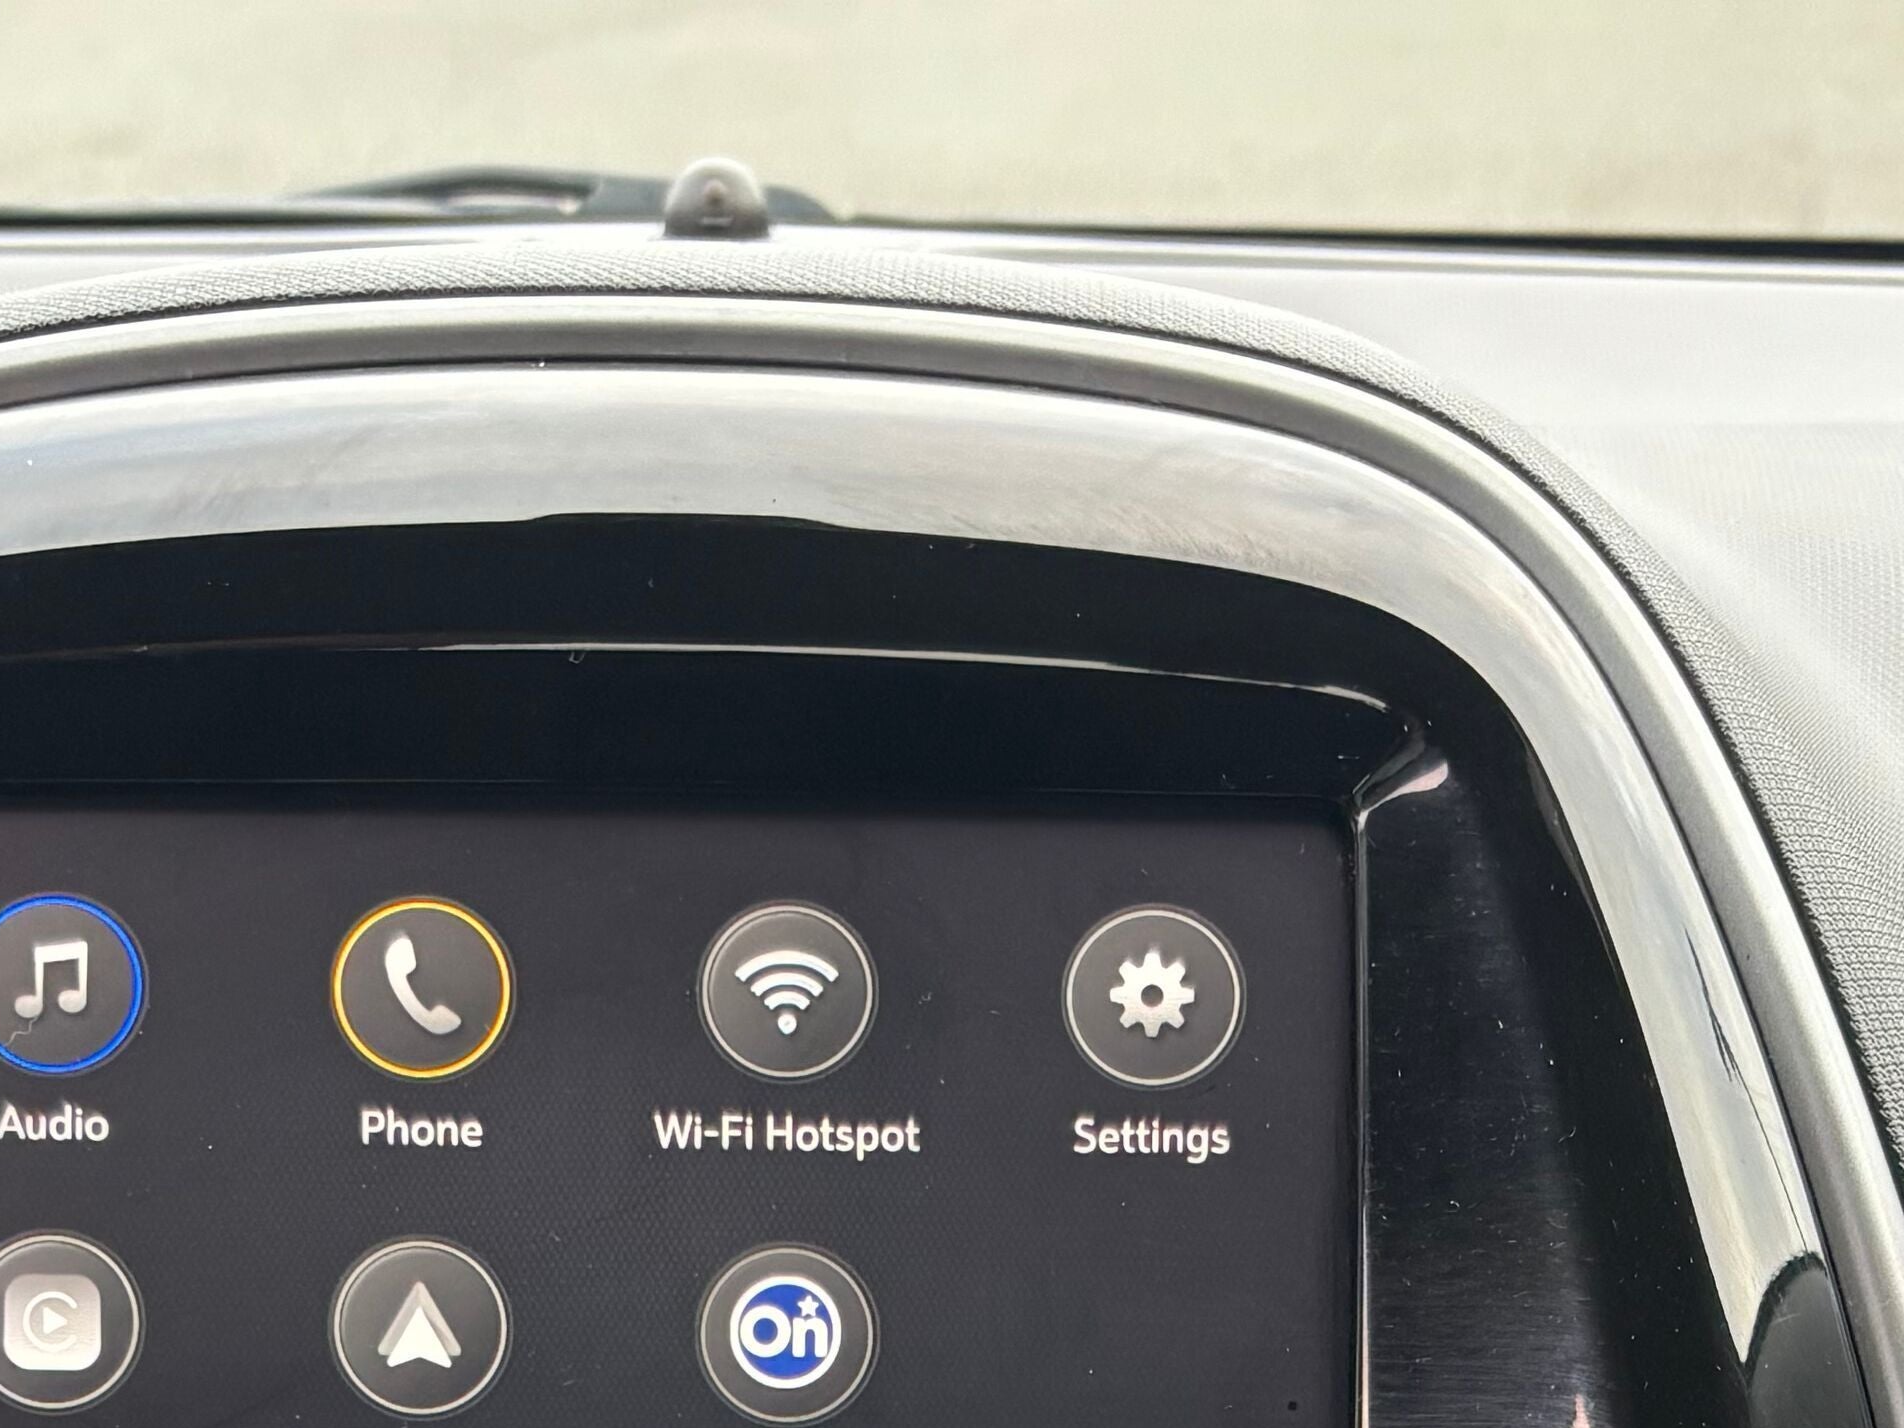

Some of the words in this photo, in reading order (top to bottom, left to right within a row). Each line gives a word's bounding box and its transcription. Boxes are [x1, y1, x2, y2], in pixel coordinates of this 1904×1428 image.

[361, 1107, 484, 1148] Phone
[653, 1111, 754, 1151] Wi-Fi
[766, 1113, 921, 1161] Hotspot
[1073, 1116, 1231, 1164] Settings
[739, 1307, 829, 1358] On
